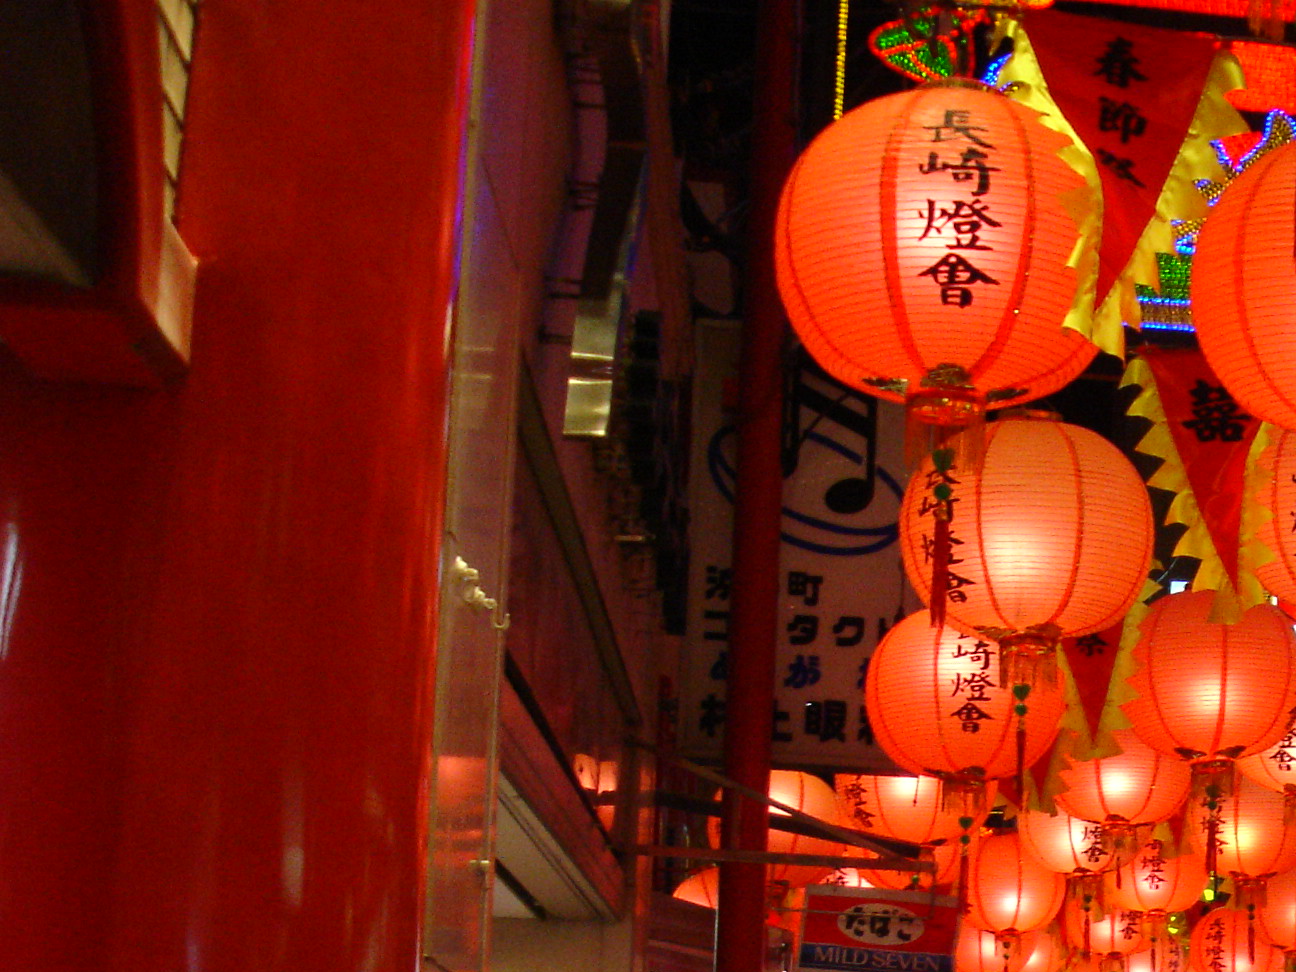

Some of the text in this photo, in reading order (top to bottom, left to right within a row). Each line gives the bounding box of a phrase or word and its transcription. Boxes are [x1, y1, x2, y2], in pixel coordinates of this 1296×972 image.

[918, 109, 1001, 309] 長崎燈會
[950, 633, 996, 734] 崎燈會
[813, 946, 941, 972] MILD SEVEN
